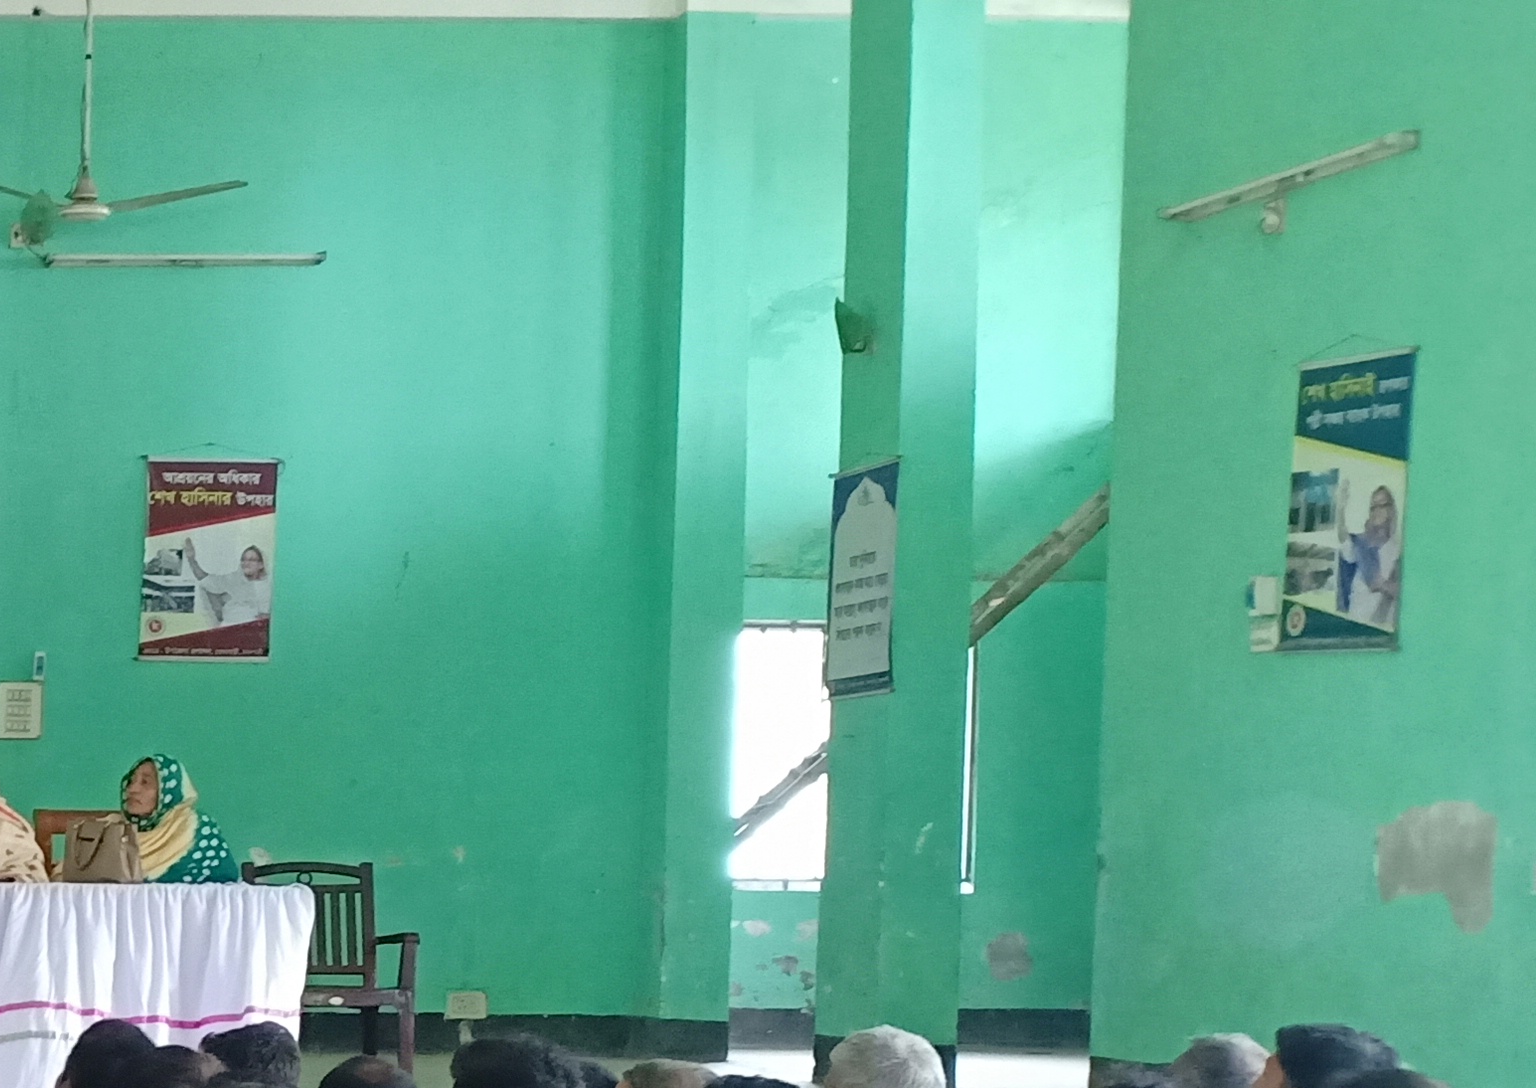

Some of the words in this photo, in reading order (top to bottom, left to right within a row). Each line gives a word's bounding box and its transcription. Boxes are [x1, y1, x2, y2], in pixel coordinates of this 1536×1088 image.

[216, 468, 263, 485] অধিকার
[148, 490, 177, 505] শেখ
[179, 486, 234, 507] হাসিনার
[235, 490, 275, 507] উপহার
